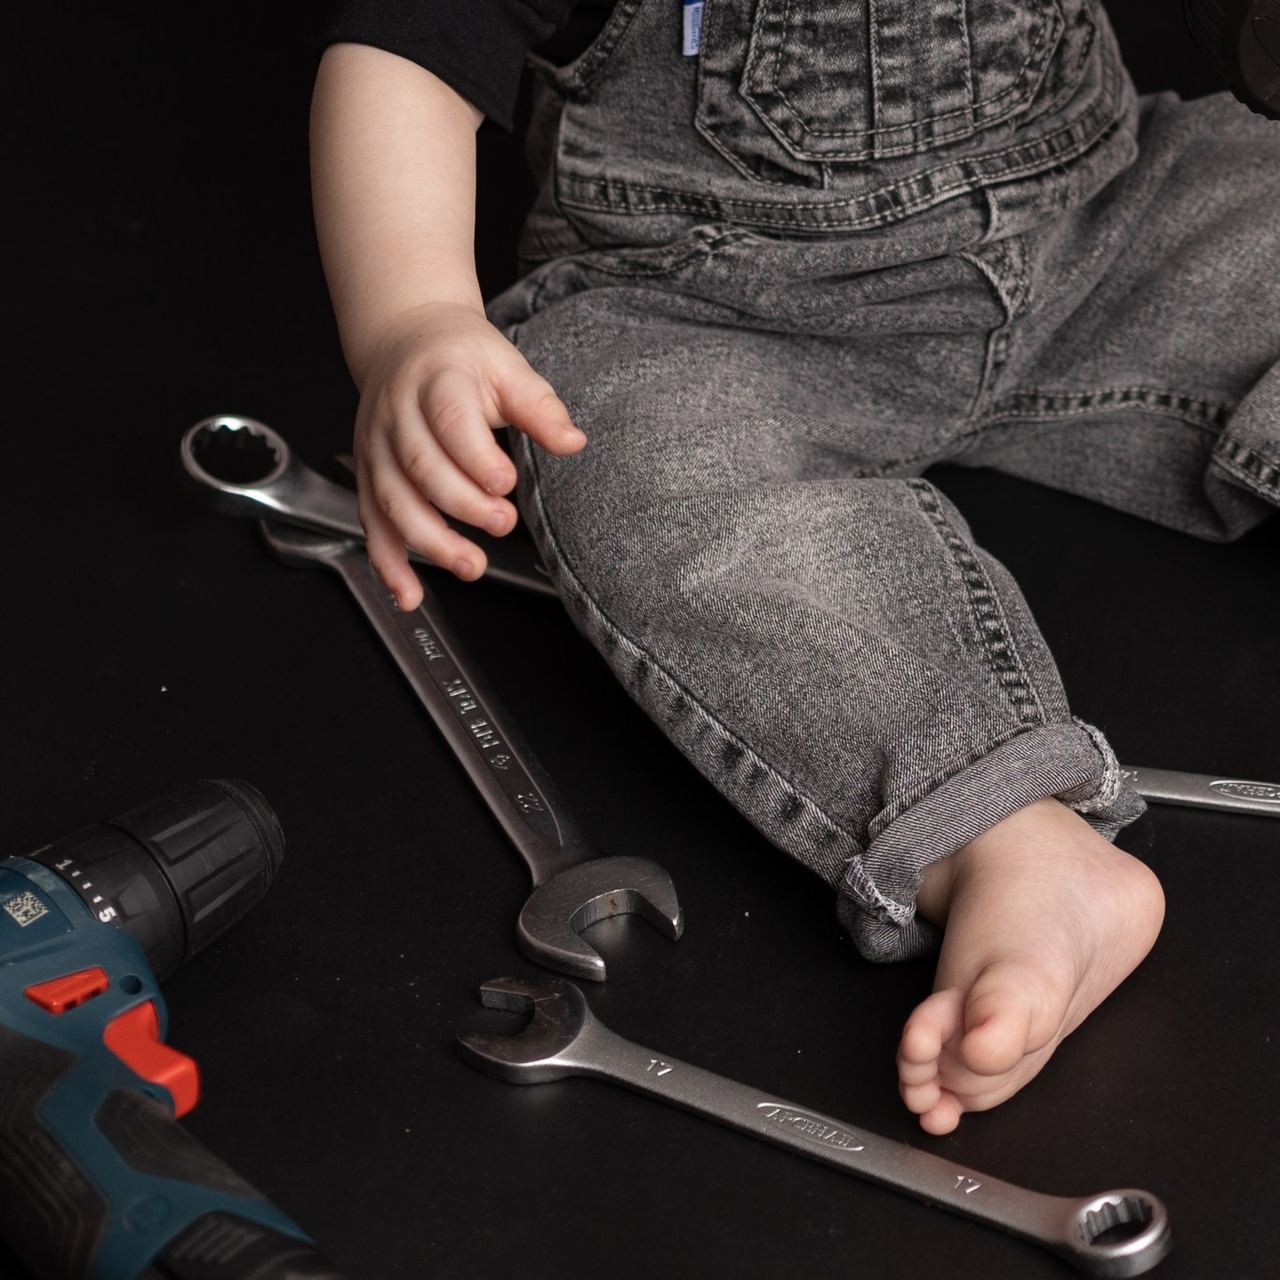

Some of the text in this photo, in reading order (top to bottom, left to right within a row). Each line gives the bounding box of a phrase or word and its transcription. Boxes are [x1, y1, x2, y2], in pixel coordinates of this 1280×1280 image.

[55, 859, 73, 870] 1
[98, 907, 117, 923] 5
[647, 1058, 674, 1077] 17
[954, 1173, 983, 1195] 17
